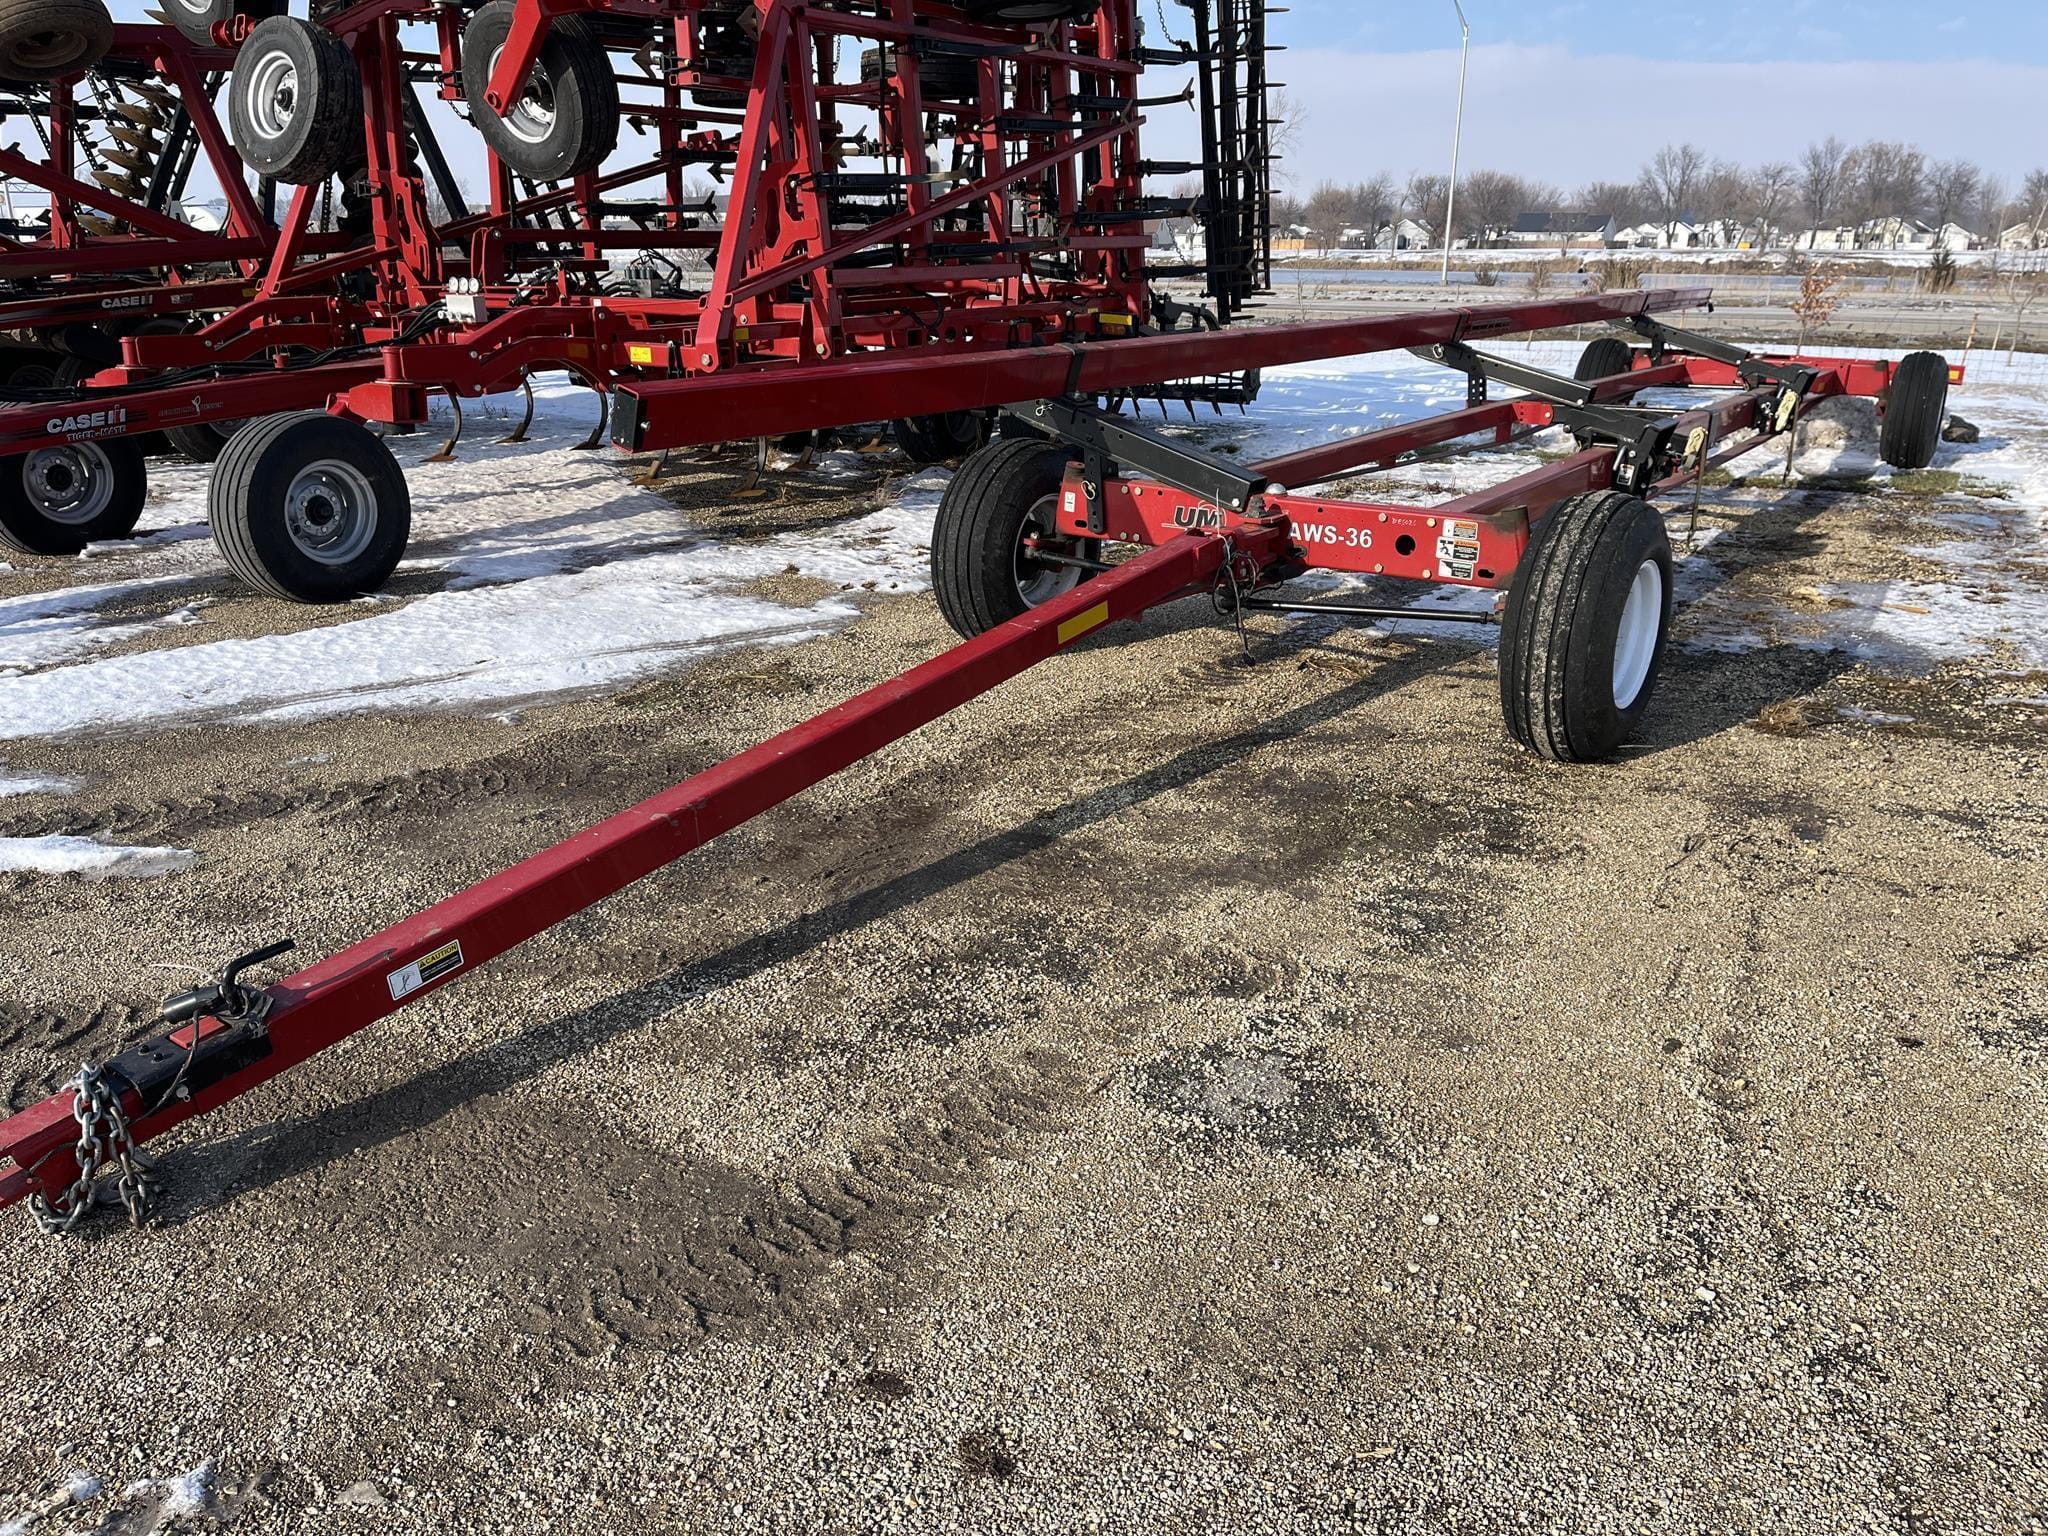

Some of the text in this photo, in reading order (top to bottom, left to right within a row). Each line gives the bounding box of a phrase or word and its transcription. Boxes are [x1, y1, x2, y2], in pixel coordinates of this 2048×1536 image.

[101, 296, 140, 309] CASE
[46, 411, 106, 434] CASE
[66, 424, 127, 441] TIGER-MATE
[1289, 521, 1373, 549] AWS-36
[425, 944, 457, 965] CAUTION
